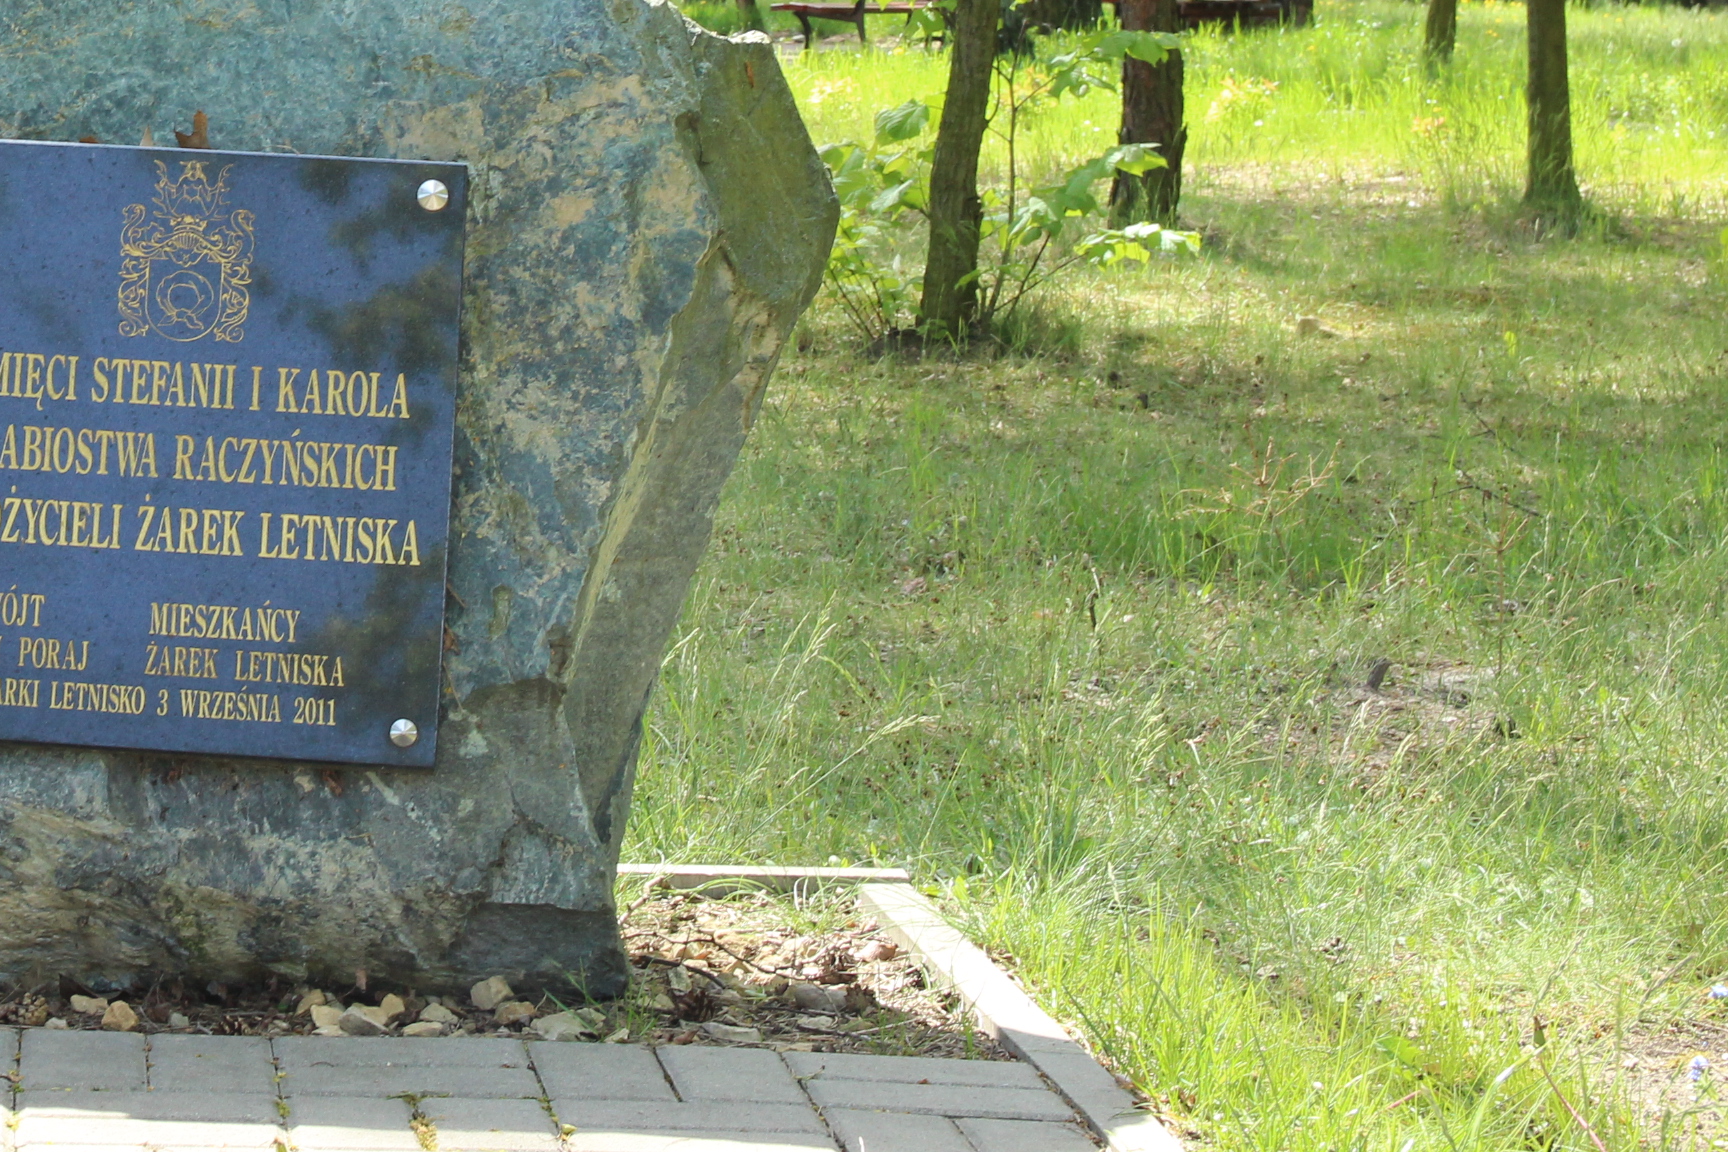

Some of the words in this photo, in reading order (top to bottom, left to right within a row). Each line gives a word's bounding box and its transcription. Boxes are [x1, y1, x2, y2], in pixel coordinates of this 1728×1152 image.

[91, 356, 238, 410] STEFANII
[249, 365, 264, 411] I
[275, 366, 411, 419] KAROLA
[172, 428, 399, 492] RACZYŃSKICH
[134, 493, 246, 557] ŻAREK
[257, 512, 422, 567] LETNISKA
[149, 600, 301, 644] MIESZKAŃCY
[17, 636, 90, 672] PORAJ
[144, 640, 220, 679] ŻAREK
[234, 650, 345, 688] LETNISKA
[49, 680, 147, 716] LETNISKO
[156, 689, 169, 717] 3
[179, 685, 282, 724] WRZEŚNIA
[293, 696, 337, 727] 2011
